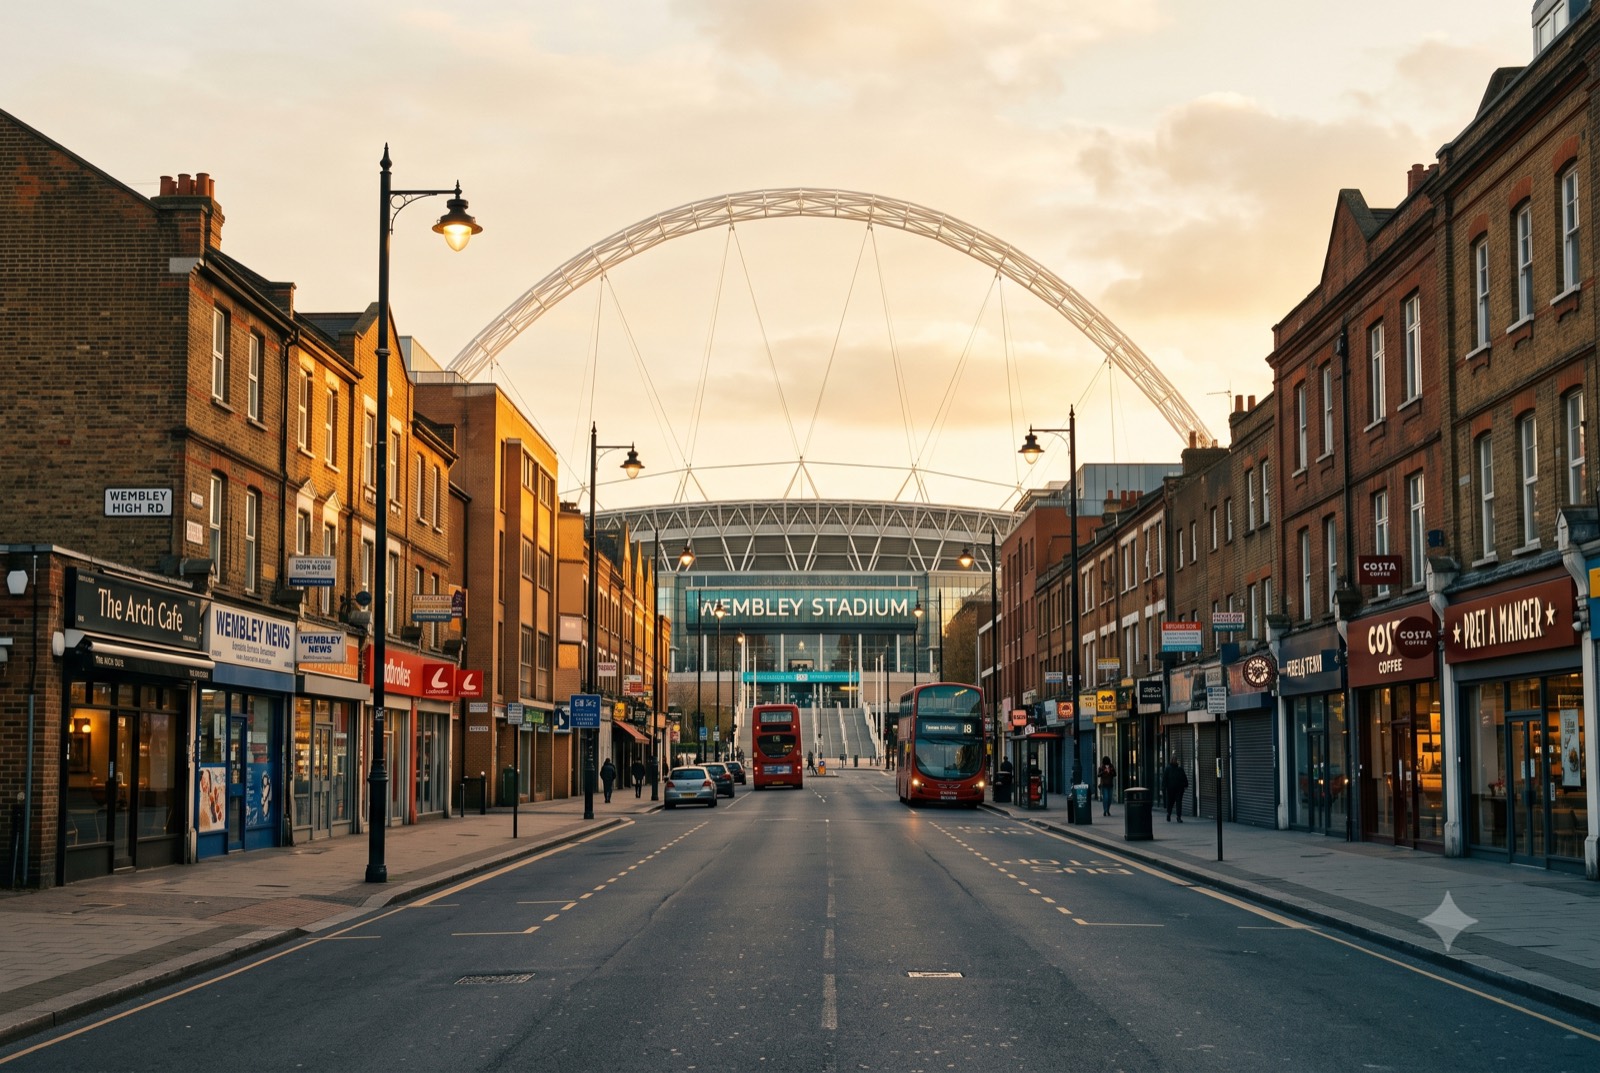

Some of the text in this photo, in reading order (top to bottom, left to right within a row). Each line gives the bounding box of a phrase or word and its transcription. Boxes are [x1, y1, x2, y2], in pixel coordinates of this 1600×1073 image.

[110, 491, 167, 501] WEMBLEY
[112, 503, 141, 513] HIGH
[1363, 562, 1396, 571] COSTA
[98, 588, 183, 632] The Arch Cafe
[697, 598, 908, 616] WEMBLEY STADIUM
[216, 609, 264, 643] WEMBLEY
[265, 621, 290, 650] NEWS
[1463, 609, 1486, 650] PRET
[1489, 606, 1496, 645] A
[1400, 630, 1432, 640] COSTA
[300, 636, 341, 645] WEMBLEY
[308, 645, 332, 653] NEWS
[1378, 658, 1403, 674] COFFEE
[963, 724, 972, 733] 18
